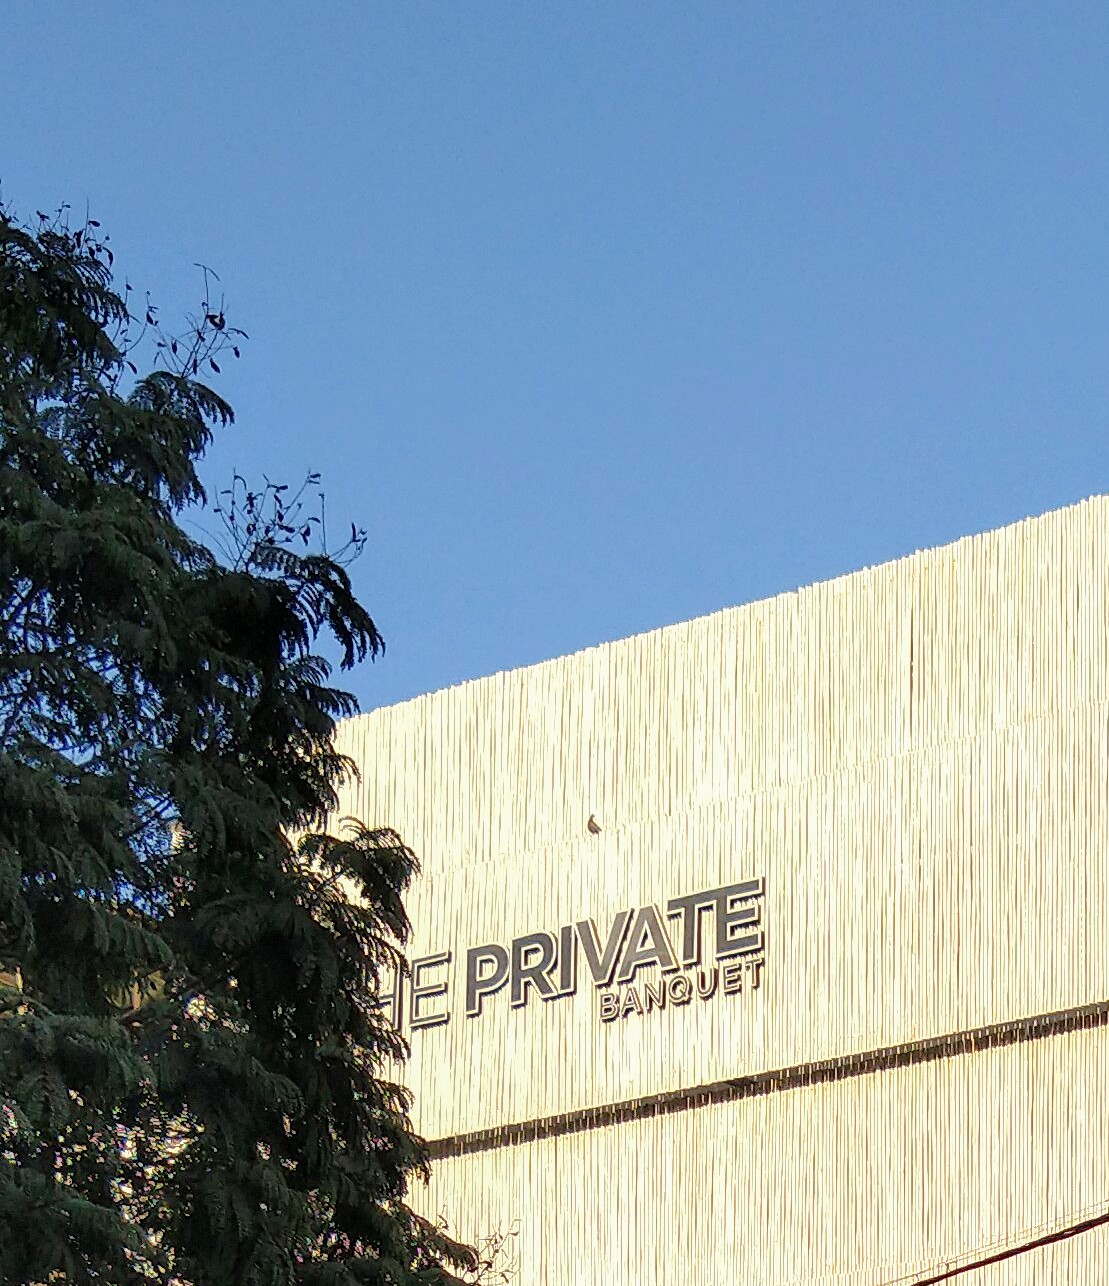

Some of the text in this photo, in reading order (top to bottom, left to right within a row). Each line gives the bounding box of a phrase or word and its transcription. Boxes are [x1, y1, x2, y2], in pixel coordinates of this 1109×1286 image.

[376, 875, 765, 1032] HE PRIVATE
[600, 957, 765, 1021] BANQUET
